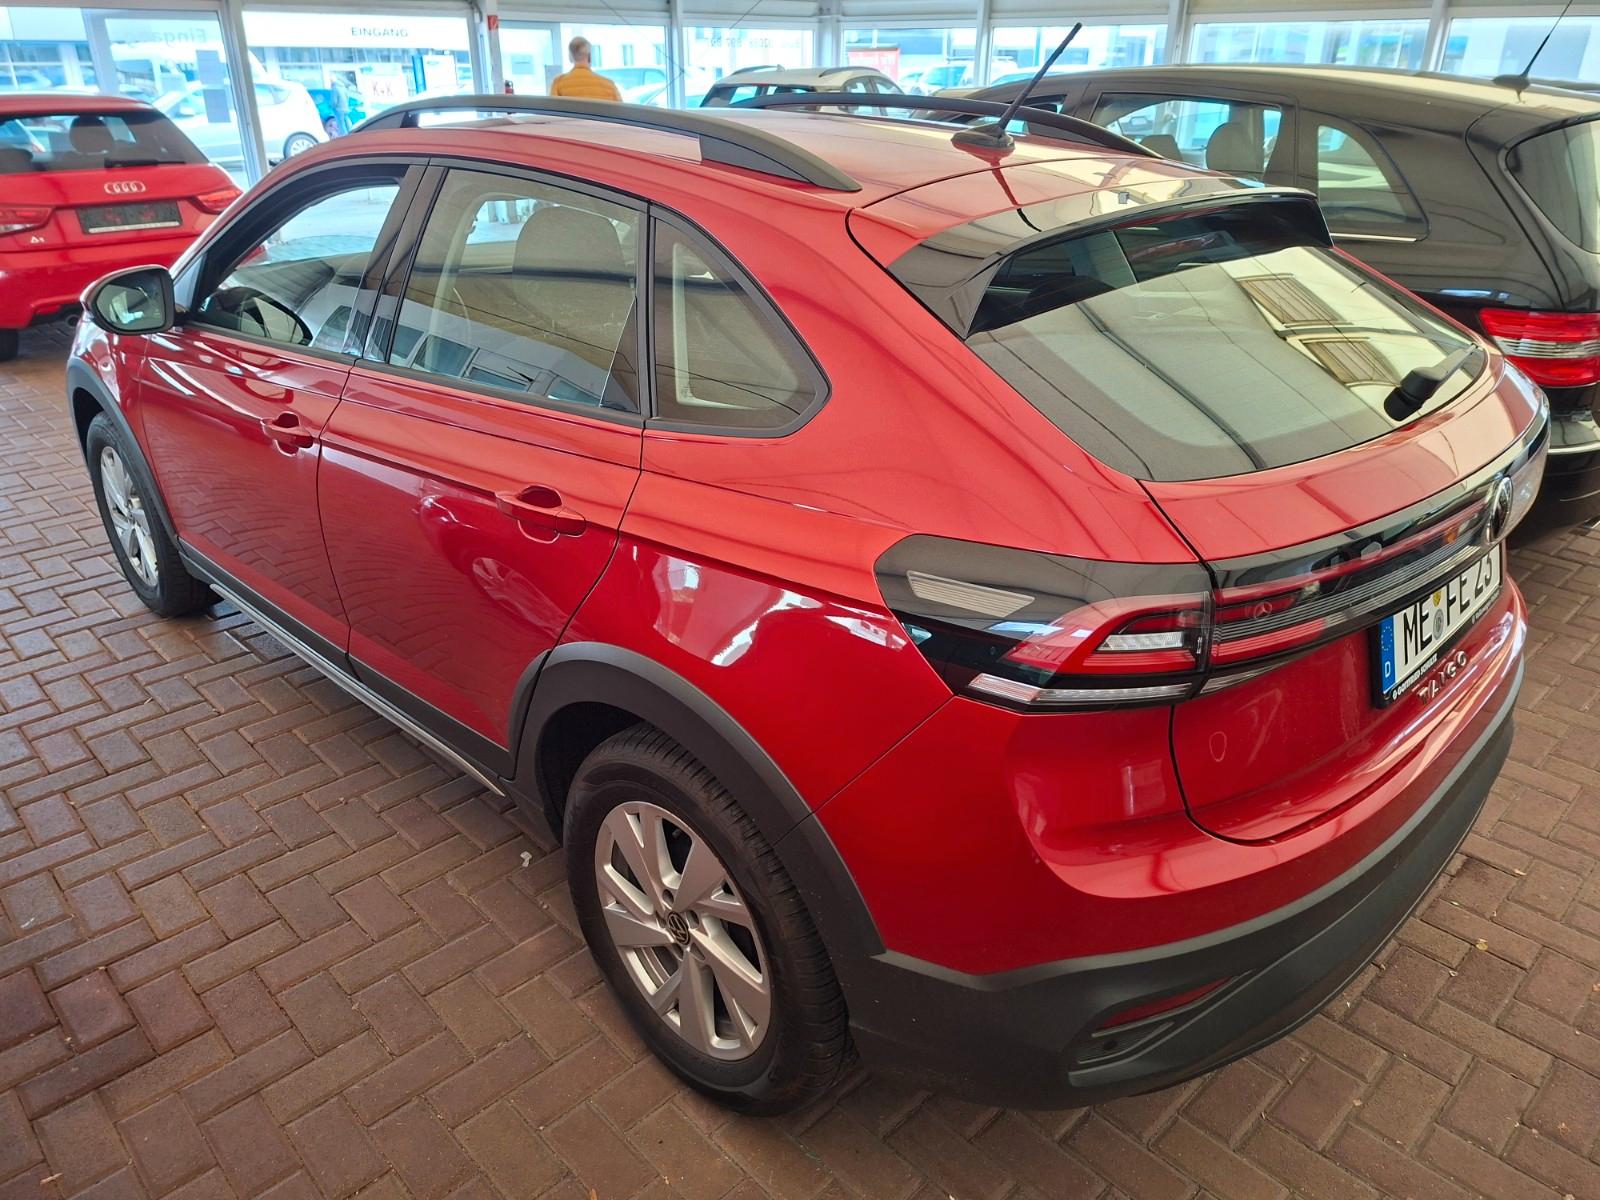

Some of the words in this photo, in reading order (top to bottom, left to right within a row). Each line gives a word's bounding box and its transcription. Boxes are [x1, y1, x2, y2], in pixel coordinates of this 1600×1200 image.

[351, 26, 409, 38] EINGANG
[1403, 594, 1432, 666] ME
[1446, 575, 1471, 627] FE
